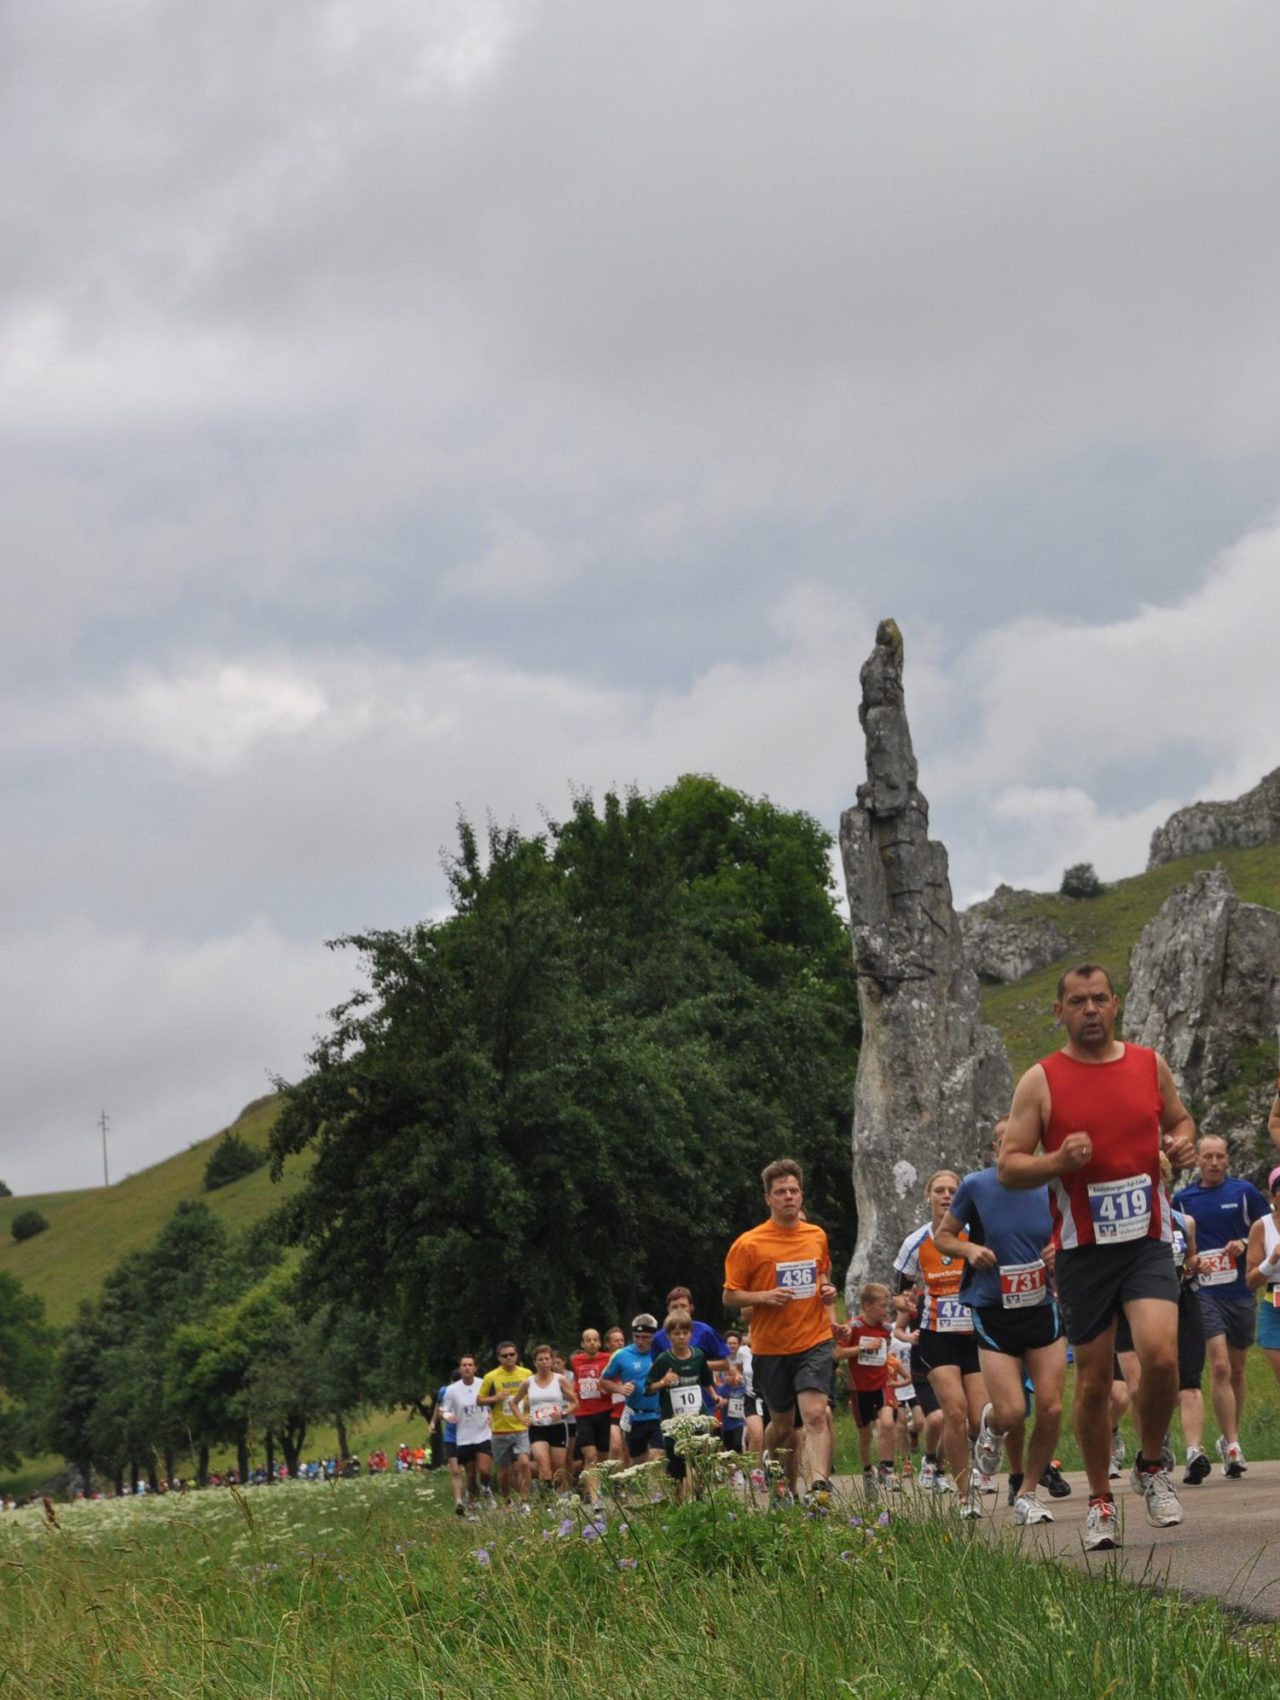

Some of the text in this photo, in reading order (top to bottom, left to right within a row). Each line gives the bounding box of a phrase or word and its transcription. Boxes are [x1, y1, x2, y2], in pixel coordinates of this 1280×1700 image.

[1099, 1189, 1147, 1220] 419
[782, 1268, 813, 1286] 436
[1007, 1270, 1041, 1293] 731
[680, 1392, 695, 1406] 10
